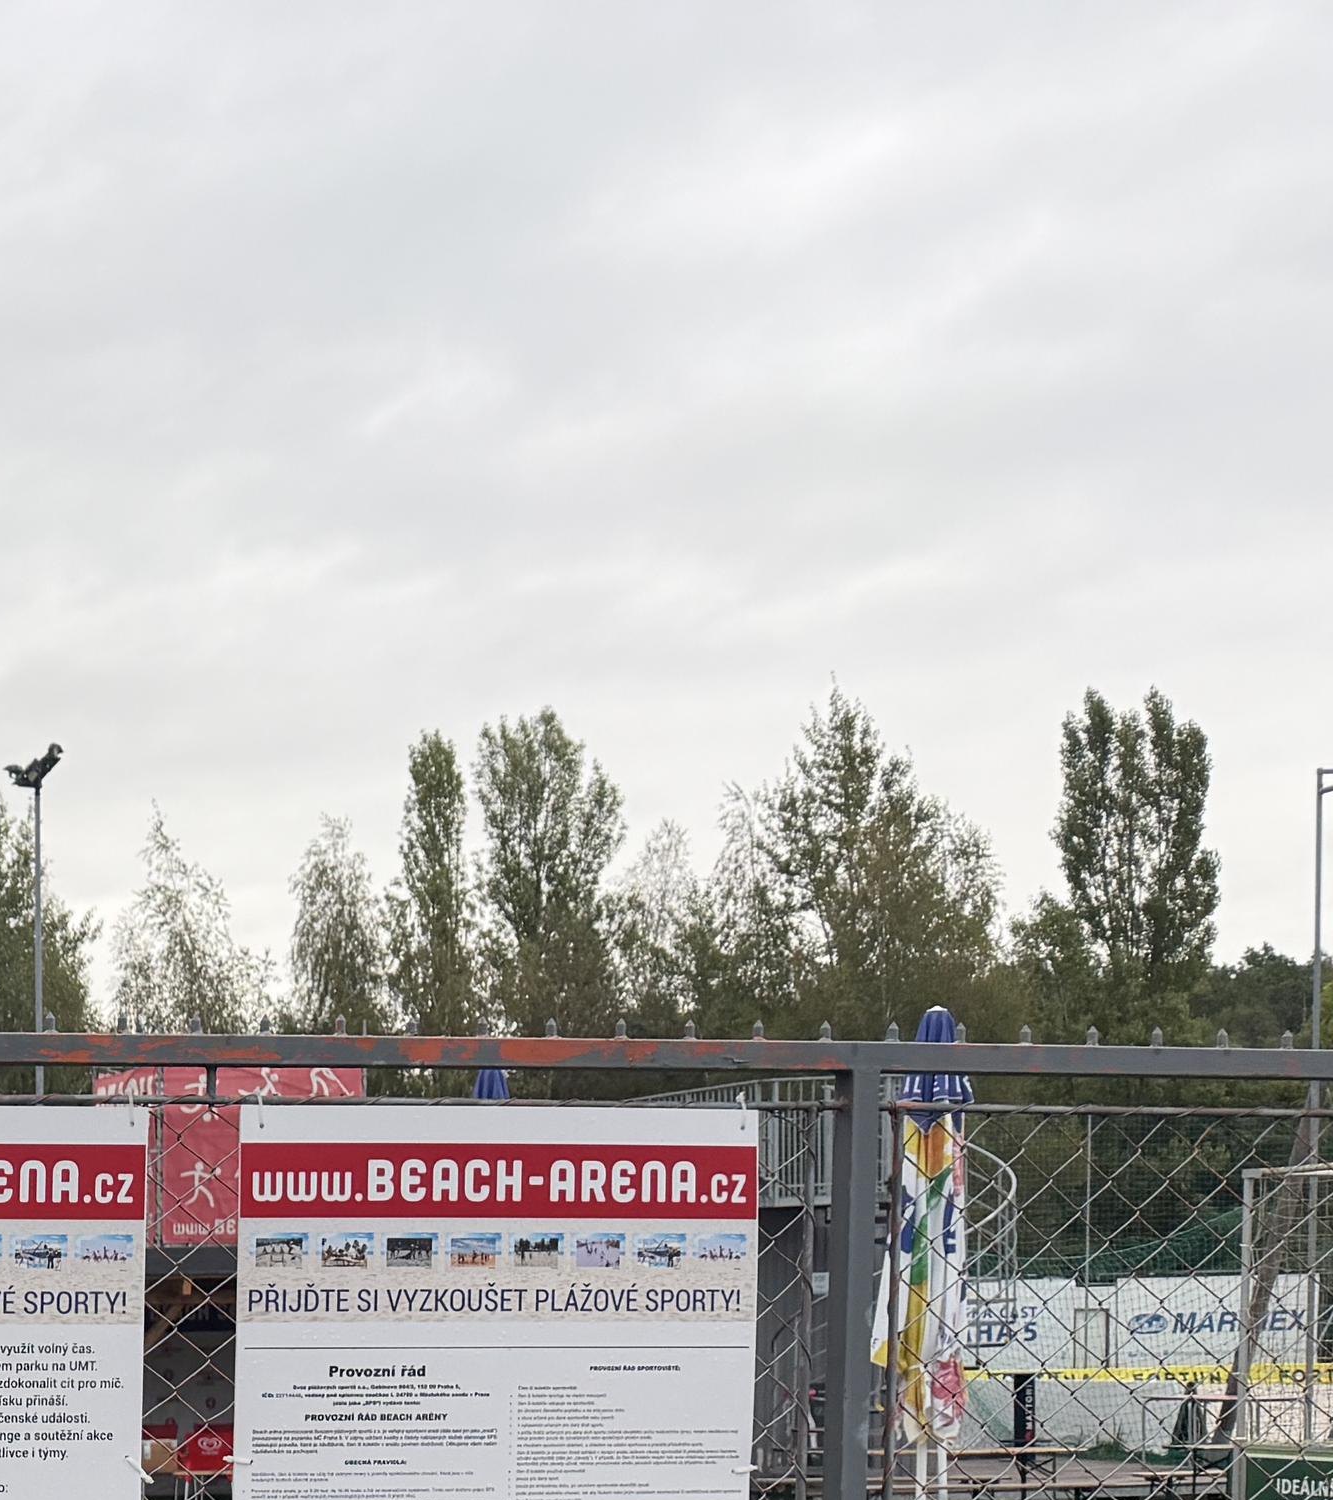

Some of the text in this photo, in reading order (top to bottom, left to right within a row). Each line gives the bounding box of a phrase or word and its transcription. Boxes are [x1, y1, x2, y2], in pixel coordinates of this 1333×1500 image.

[252, 1159, 747, 1204] www.BEACH-ARENA.cz
[23, 1291, 127, 1314] SPORTY!
[248, 1283, 741, 1312] PŘIJĎTE SI VYZKOUŠET PLÁŽOVÉ SPORTY!
[1172, 1310, 1306, 1334] MAREX
[0, 1343, 35, 1356] využít
[37, 1343, 69, 1356] volný
[71, 1343, 95, 1353] čas.
[15, 1360, 49, 1373] parku
[51, 1363, 66, 1371] na
[69, 1361, 98, 1371] UMT.
[328, 1365, 426, 1377] Provozní řád
[60, 1378, 75, 1388] cit
[77, 1381, 97, 1391] pro
[99, 1378, 124, 1388] míč.
[25, 1395, 69, 1408] přináší.
[41, 1412, 91, 1423] události.
[304, 1413, 355, 1421] PROVOZNÍ
[357, 1413, 378, 1421] ŘÁD
[414, 1413, 448, 1421] ARÉNY
[31, 1448, 35, 1457] i
[38, 1448, 69, 1460] týmy.
